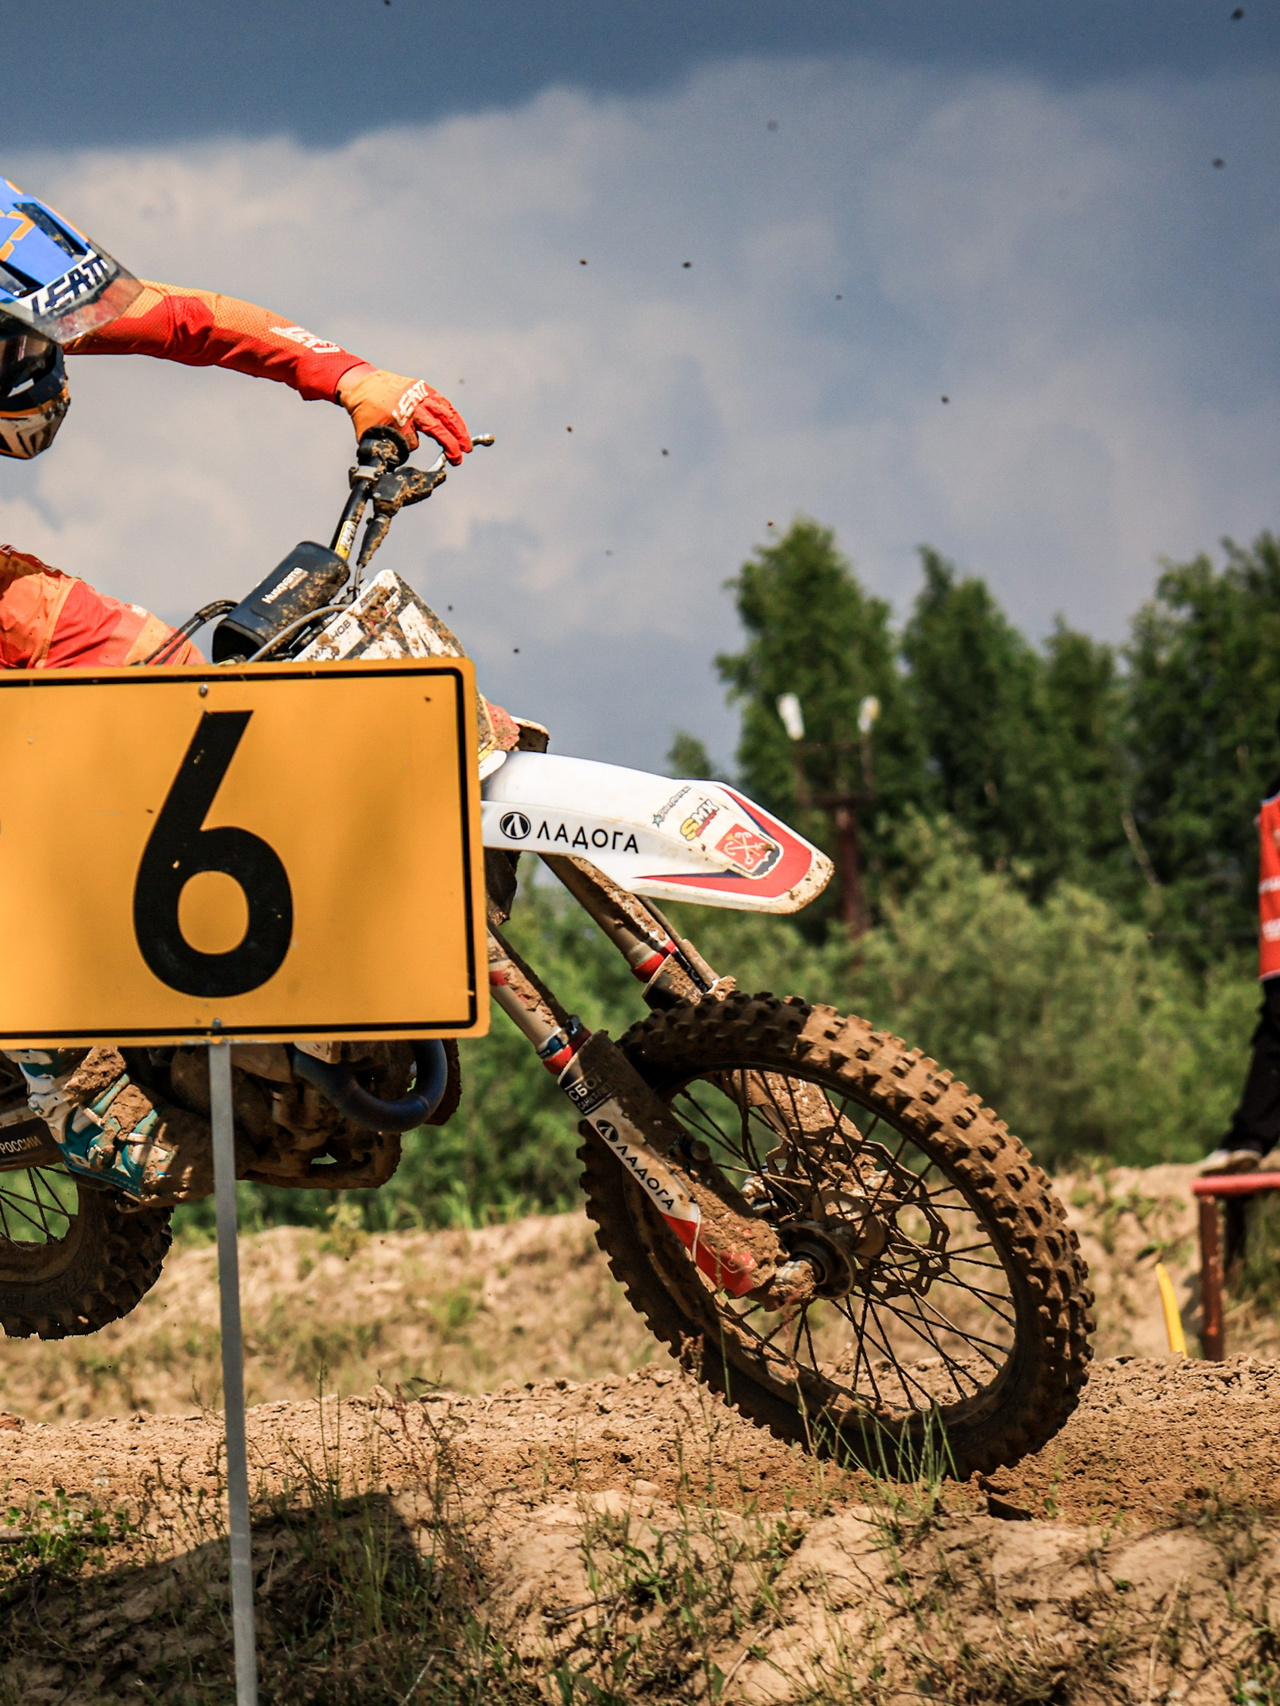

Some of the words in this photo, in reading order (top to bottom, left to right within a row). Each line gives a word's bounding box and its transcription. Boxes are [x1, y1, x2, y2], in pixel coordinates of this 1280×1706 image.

[31, 257, 110, 315] LEATT
[392, 379, 429, 427] LEATT
[537, 820, 640, 855] ЛАДОГА
[679, 797, 720, 842] SMX
[132, 709, 294, 998] 6
[616, 1144, 675, 1210] ЛАДОГА
